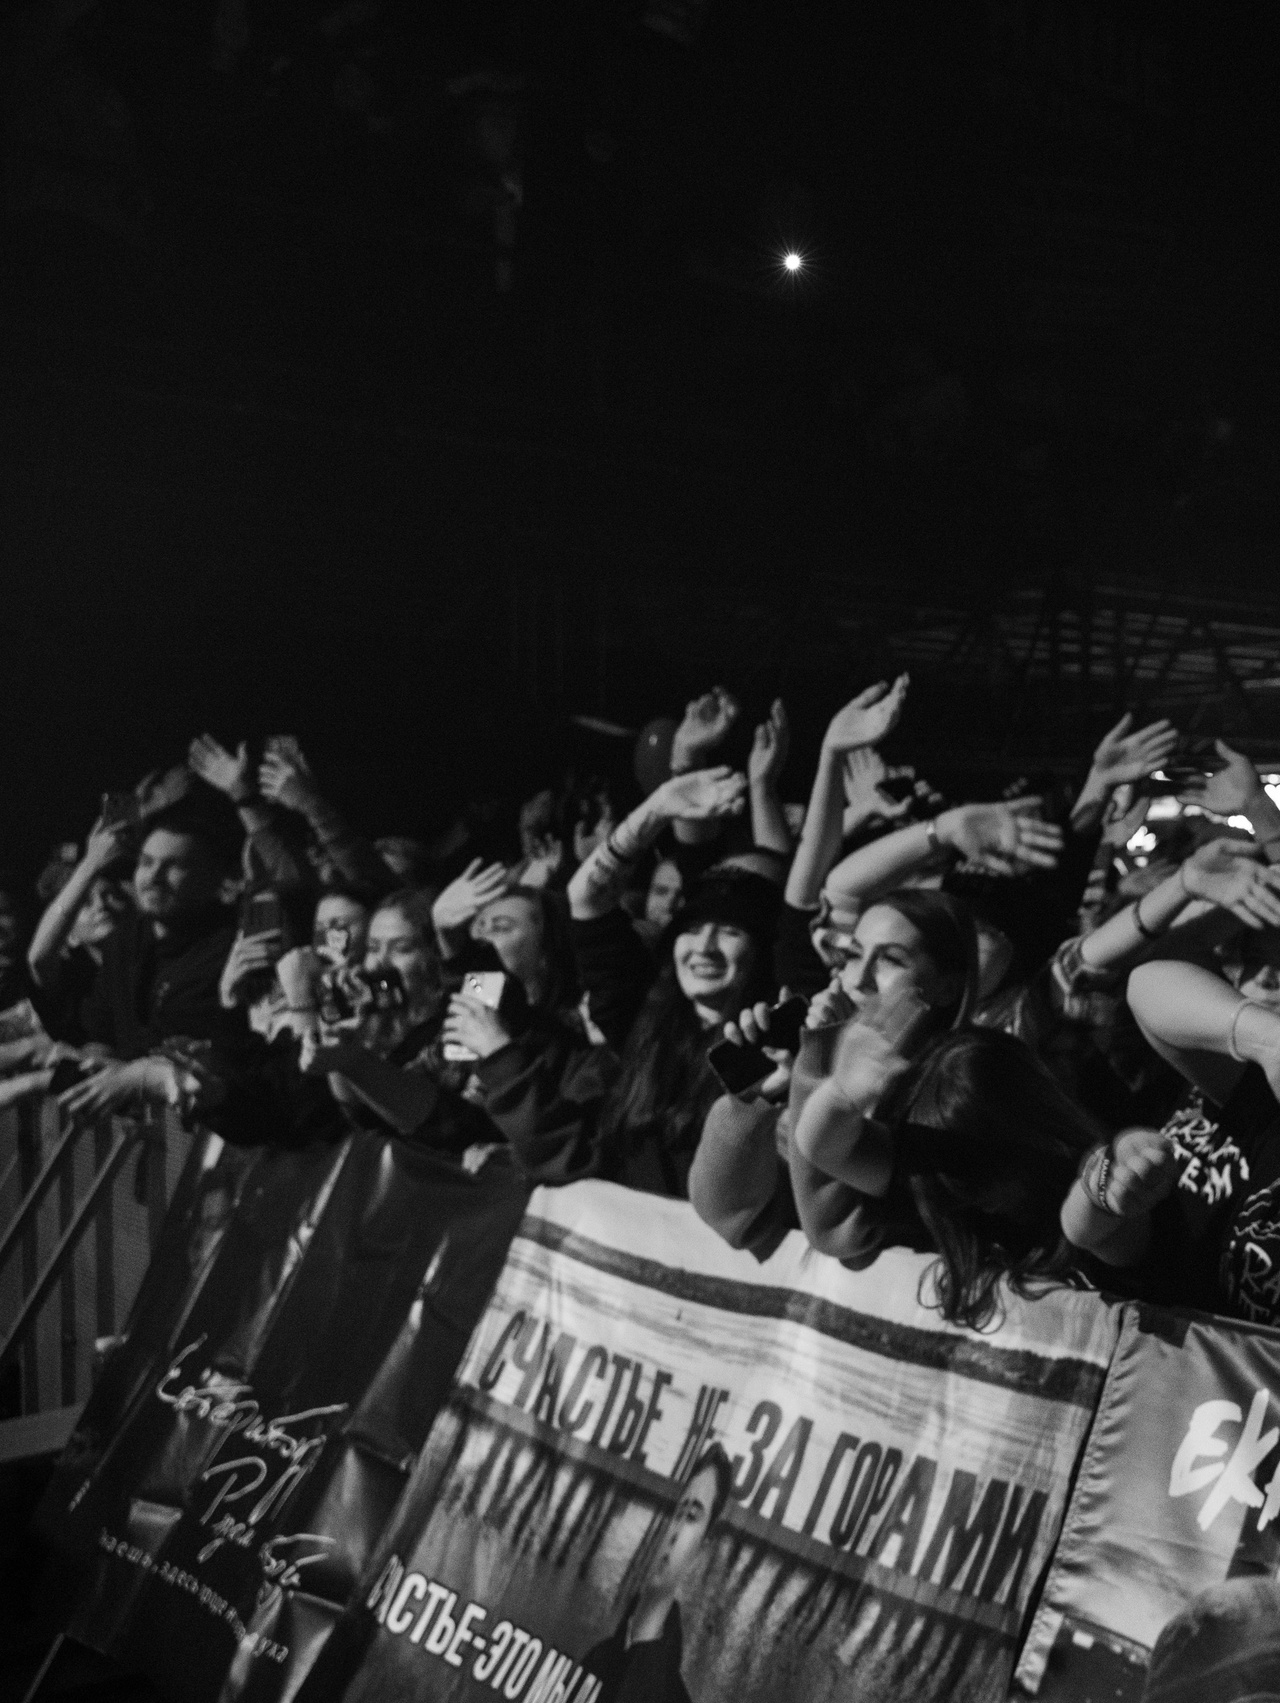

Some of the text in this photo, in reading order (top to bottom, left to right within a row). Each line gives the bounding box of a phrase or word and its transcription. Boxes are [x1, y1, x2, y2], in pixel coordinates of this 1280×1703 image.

[478, 1309, 673, 1465] СЧАСТЬЕ
[729, 1398, 815, 1527] ЗА
[801, 1430, 1049, 1607] ГОРАМИ
